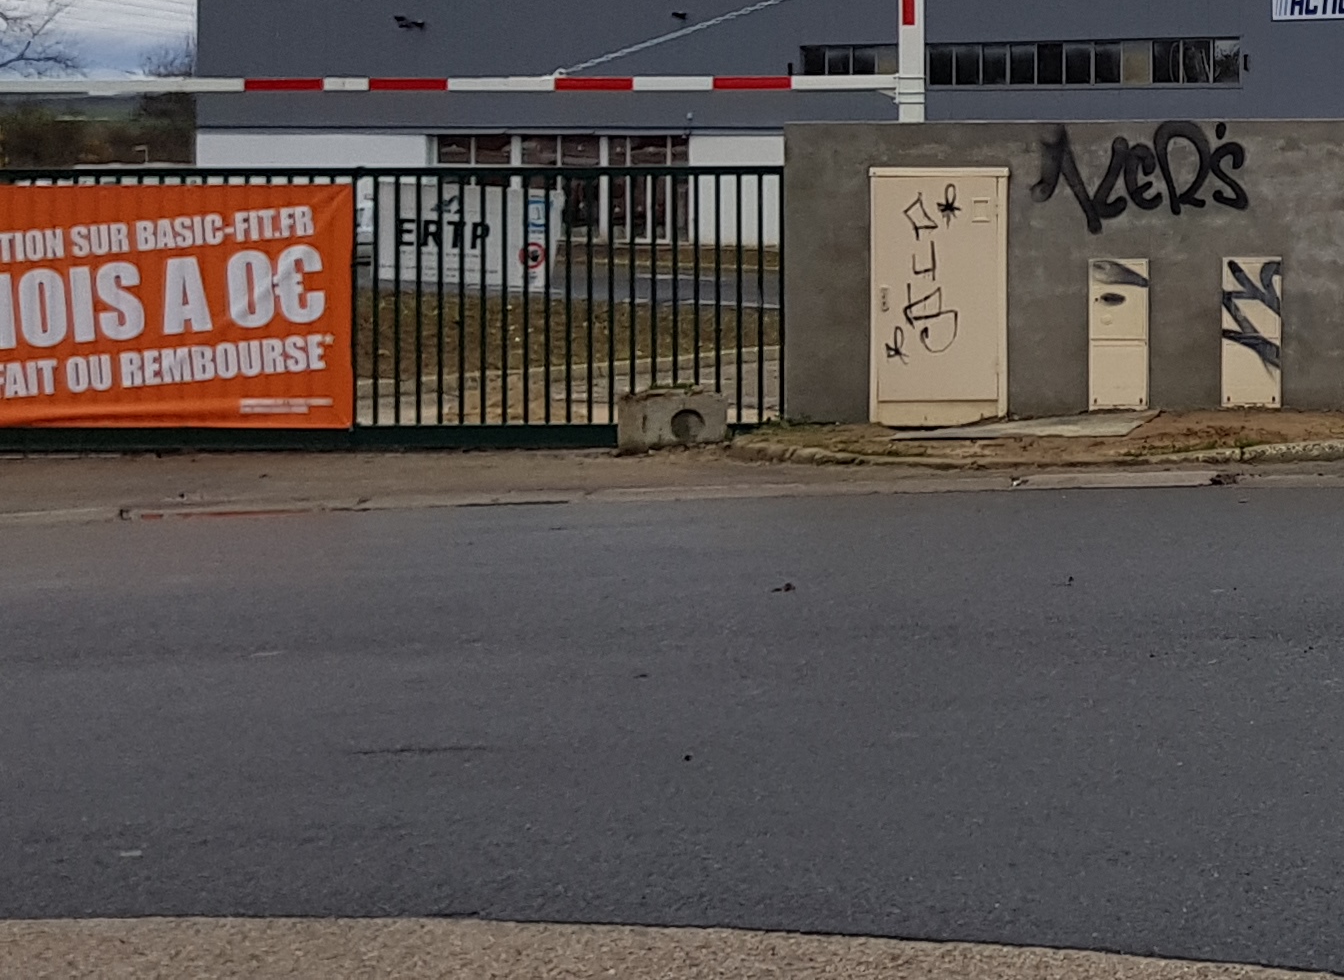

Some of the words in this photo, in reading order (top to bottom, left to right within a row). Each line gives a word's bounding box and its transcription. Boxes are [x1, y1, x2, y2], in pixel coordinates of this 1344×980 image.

[0, 228, 65, 263] TION
[70, 222, 130, 258] SUR
[135, 205, 315, 251] BASIC-FIT.FR
[0, 261, 146, 350] OIS
[163, 255, 213, 336] A
[227, 243, 326, 328] 0€
[66, 353, 113, 394] OU
